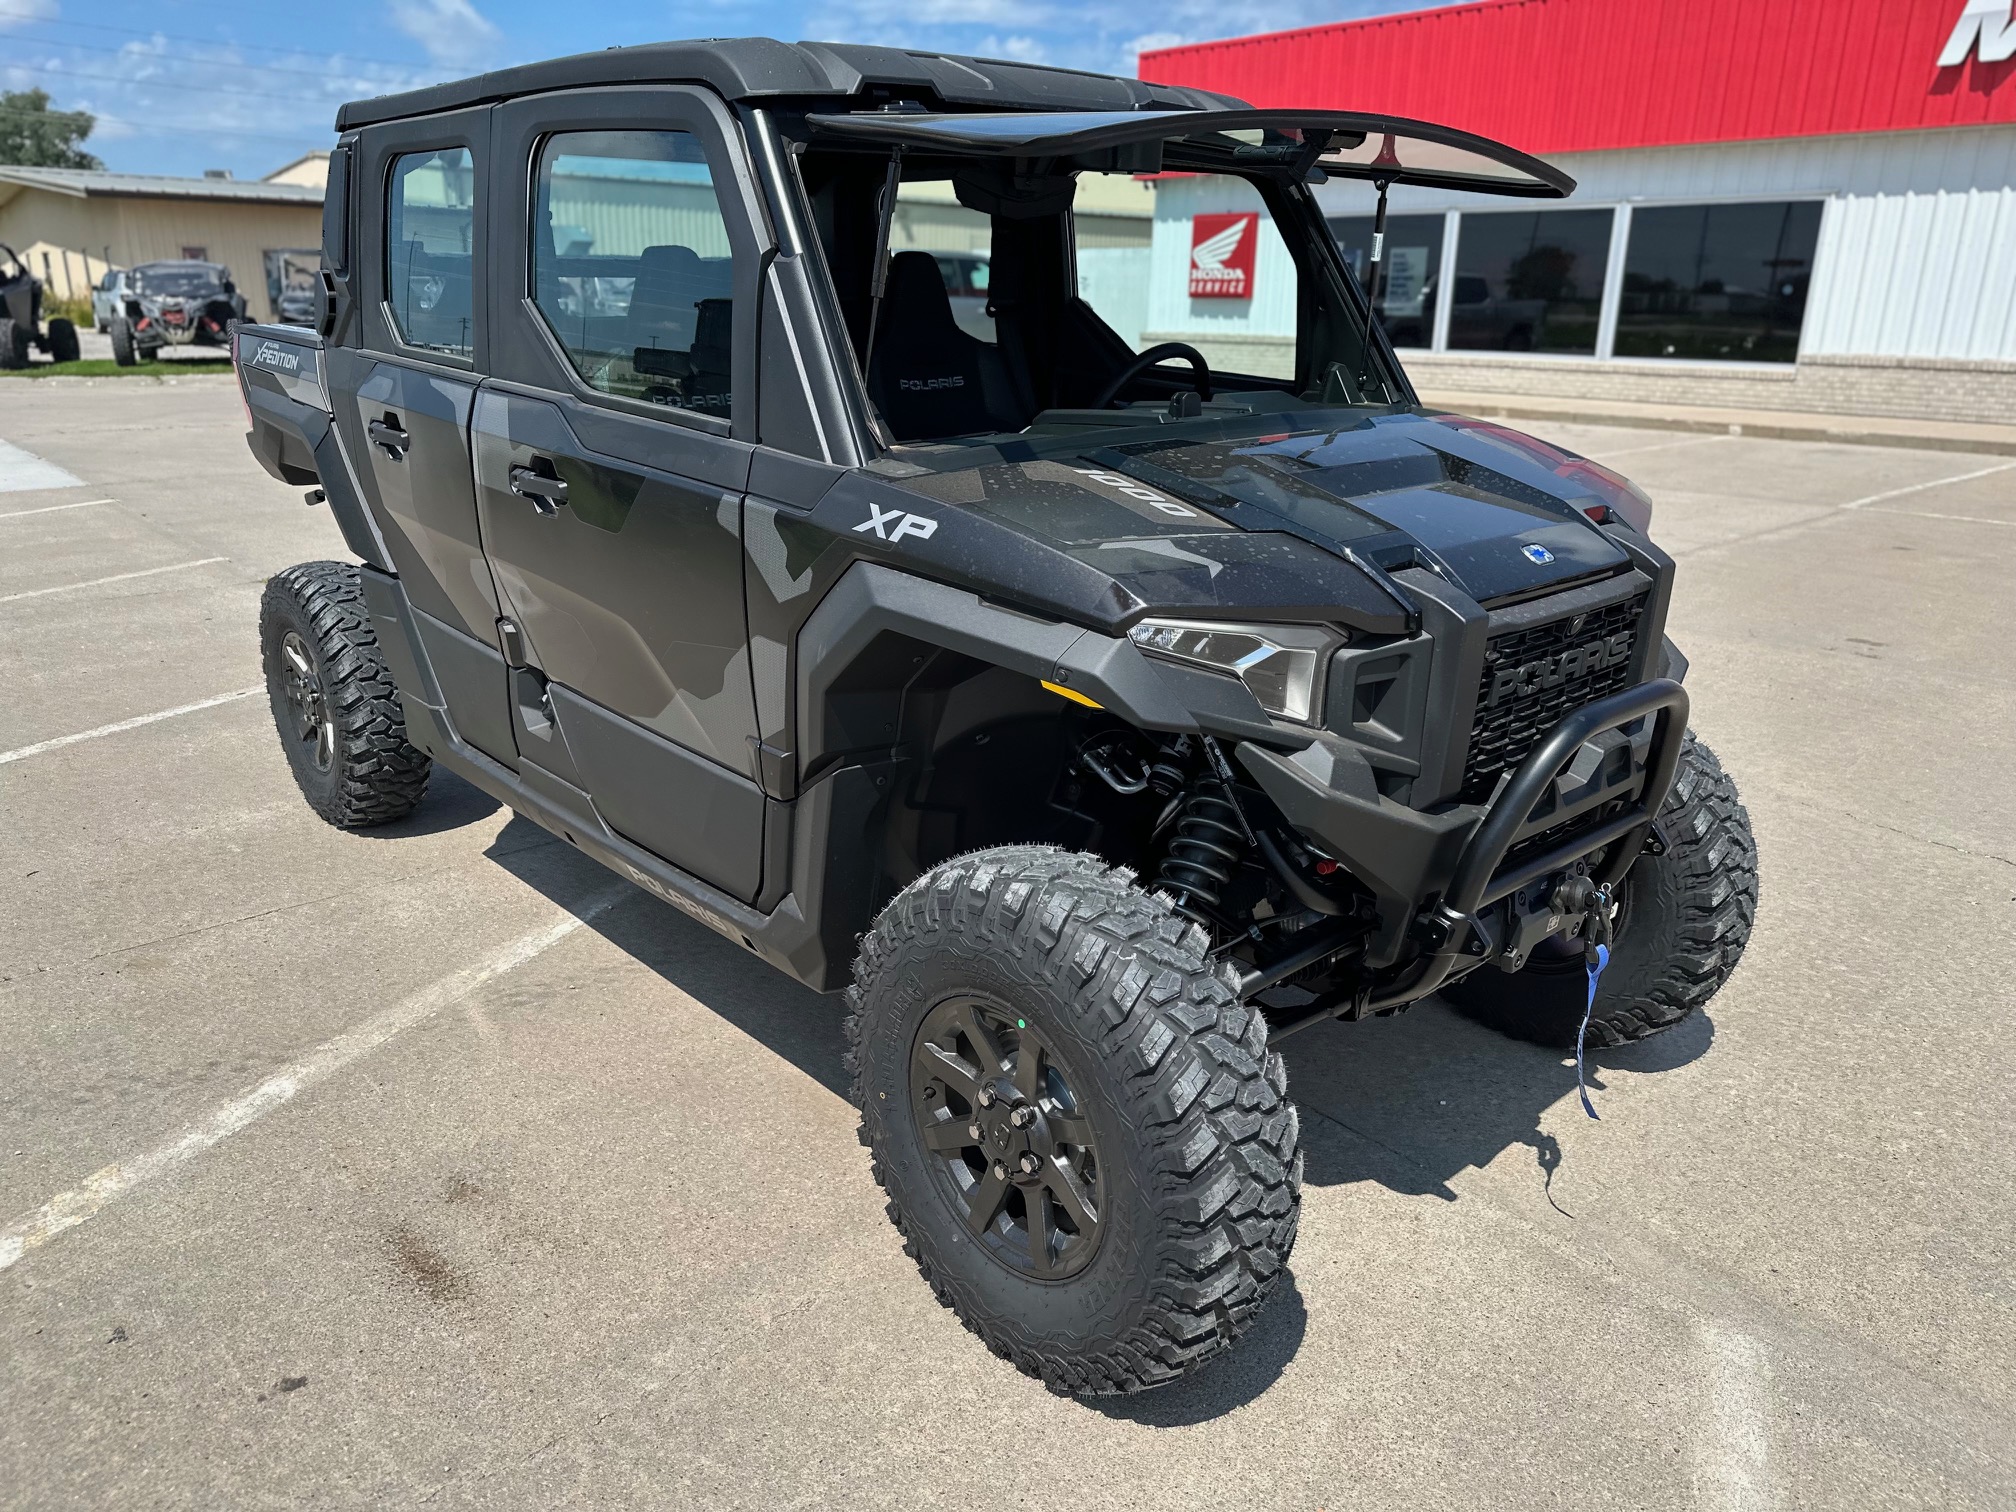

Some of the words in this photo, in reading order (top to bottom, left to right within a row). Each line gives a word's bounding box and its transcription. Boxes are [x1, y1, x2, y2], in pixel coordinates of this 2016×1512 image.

[1190, 281, 1245, 294] SERVICE
[1191, 268, 1246, 280] HONDA
[252, 341, 299, 370] XPEDITION
[900, 376, 965, 390] POLARIS
[1073, 469, 1198, 518] 1000
[852, 502, 938, 543] XP
[1487, 630, 1633, 707] POLARIS
[625, 864, 728, 932] POLARIS
